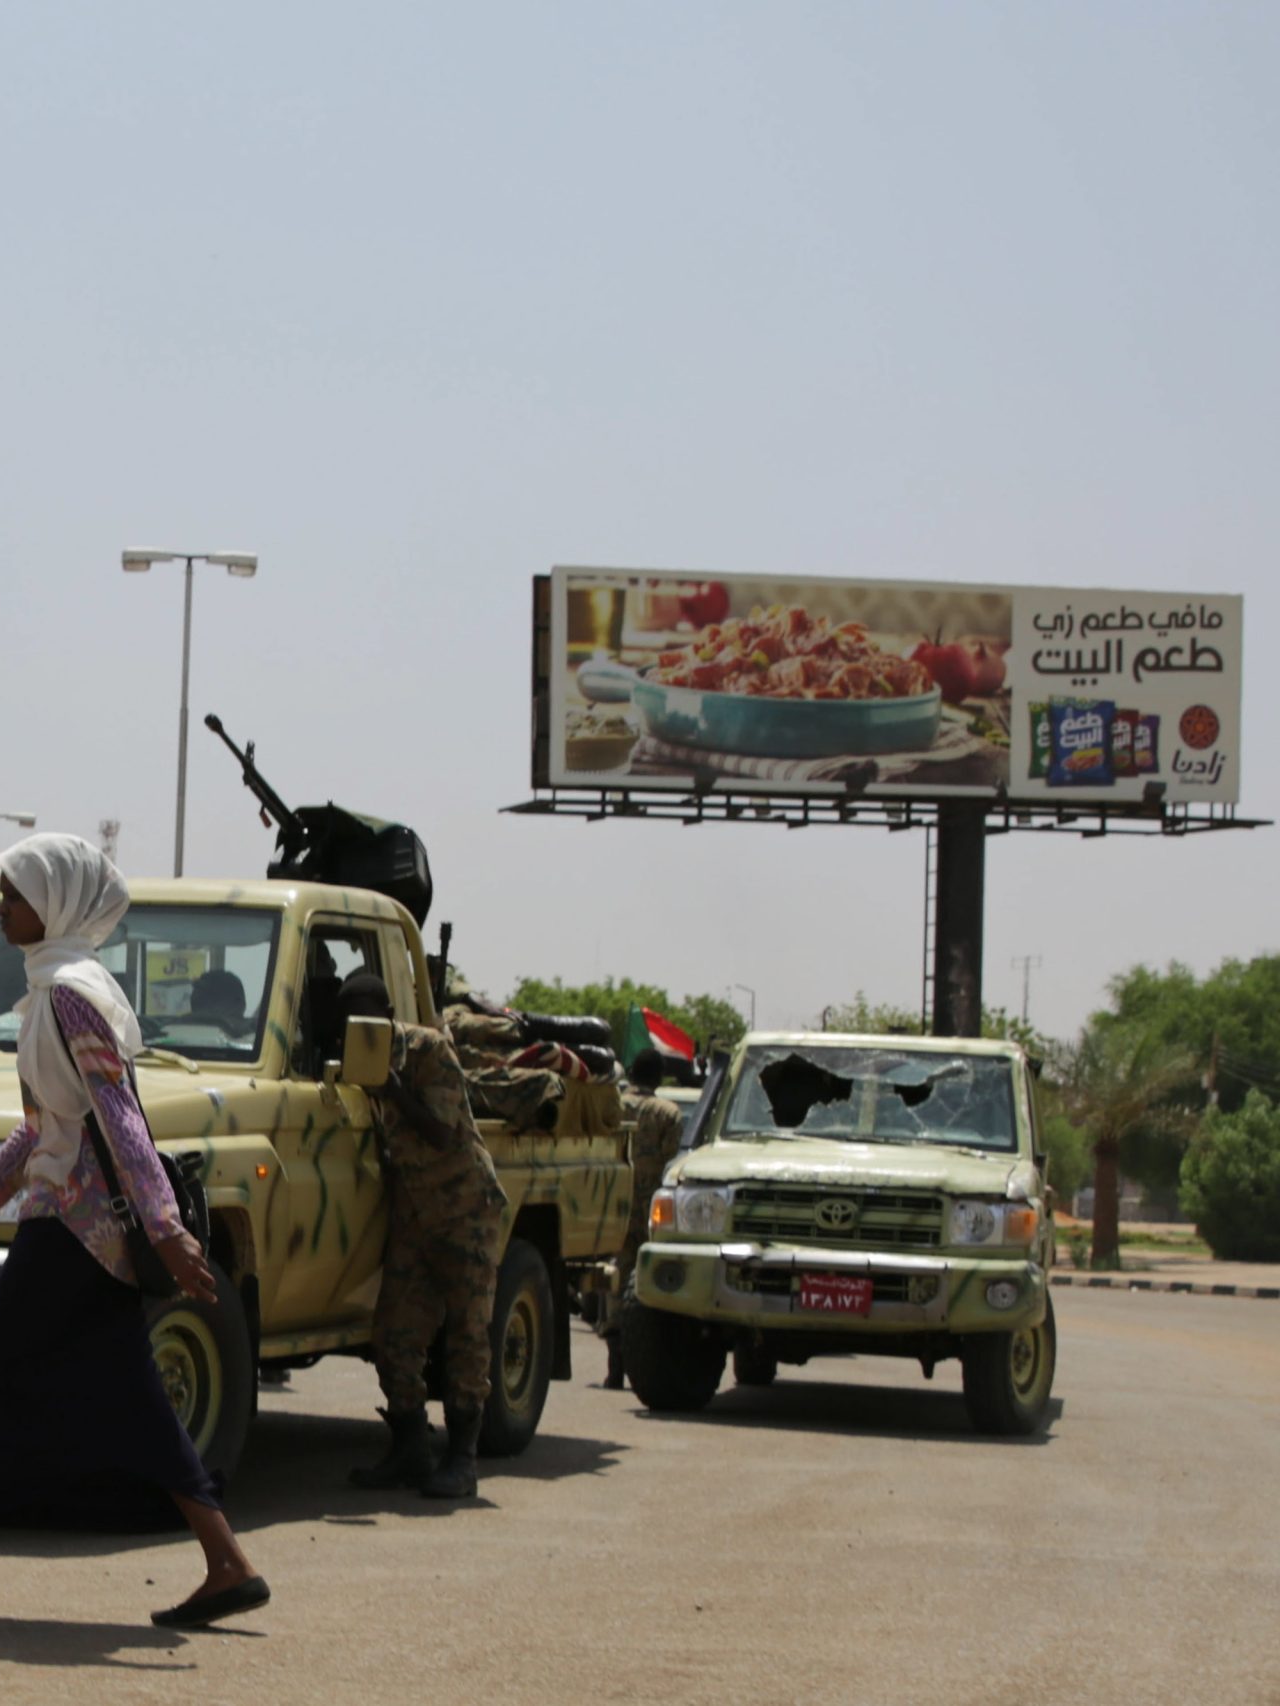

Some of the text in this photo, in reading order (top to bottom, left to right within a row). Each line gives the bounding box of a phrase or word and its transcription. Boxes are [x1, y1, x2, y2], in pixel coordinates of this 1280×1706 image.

[1032, 605, 1074, 640] زي
[1080, 605, 1144, 639] طعم
[1031, 637, 1224, 687] طعم البيت
[1171, 749, 1226, 784] زادنا
